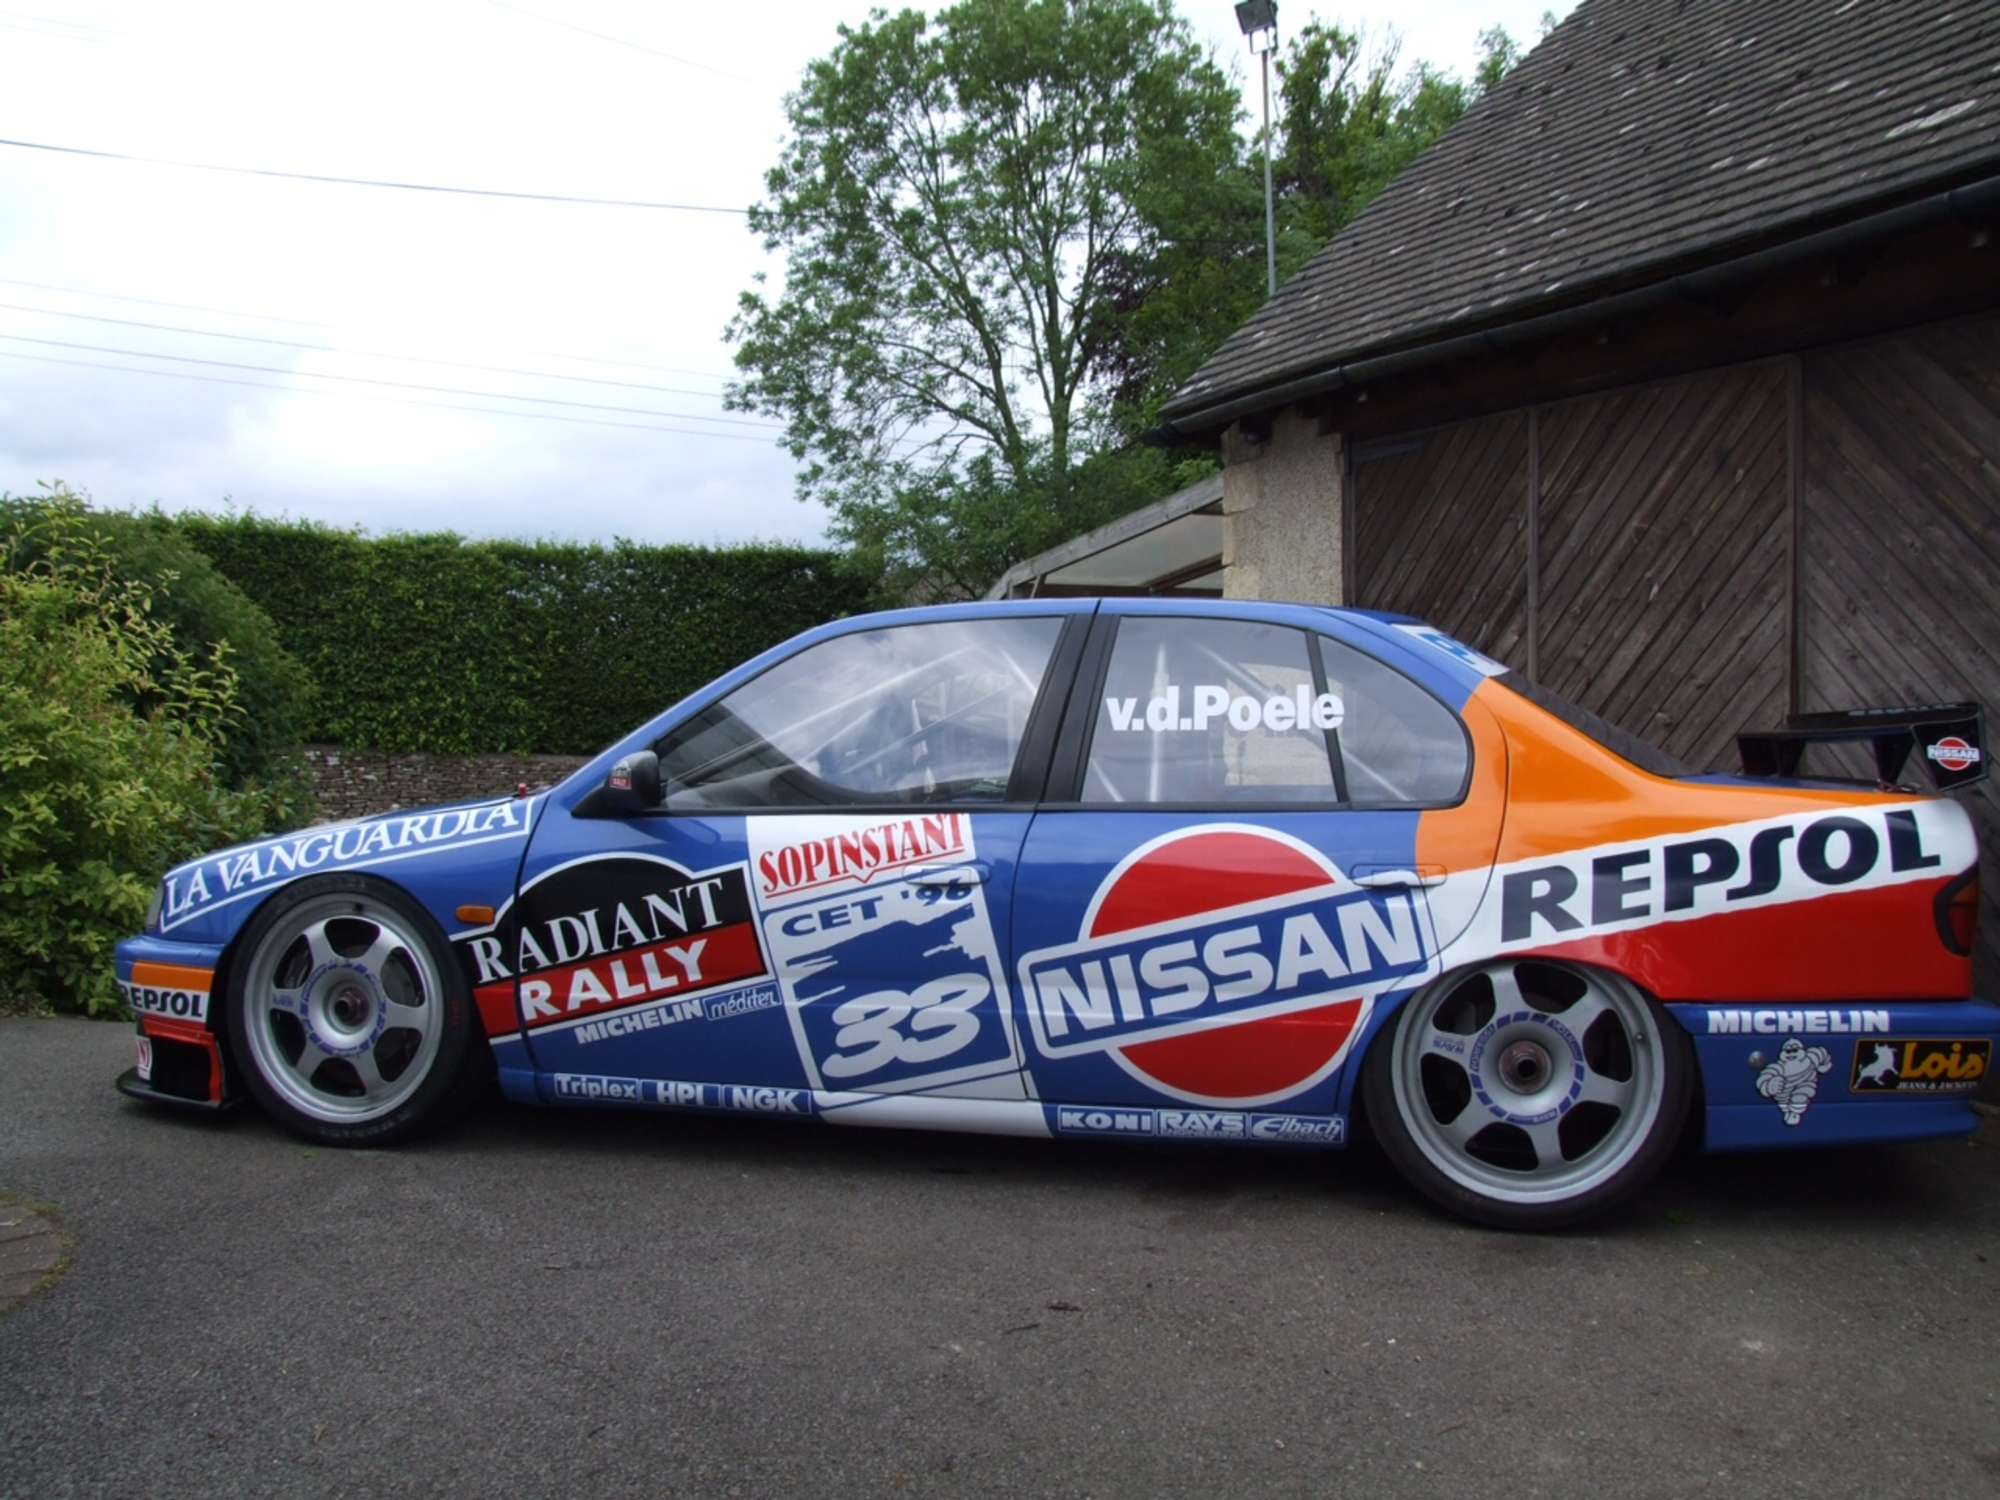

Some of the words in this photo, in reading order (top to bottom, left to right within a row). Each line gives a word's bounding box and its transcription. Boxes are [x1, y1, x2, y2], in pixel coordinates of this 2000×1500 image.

[1106, 685, 1345, 732] v.d.Poele
[166, 868, 212, 917] LA
[217, 802, 519, 891] VANGUARDIA
[759, 812, 964, 893] SOPINSTANT
[1501, 810, 1941, 943] REPSOL
[467, 878, 723, 984] RADIANT
[782, 897, 883, 937] CET
[519, 938, 708, 1022] RALLY
[1036, 895, 1421, 1038] NISSAN
[574, 999, 703, 1044] MICHELIN
[821, 973, 990, 1078] 33
[1707, 1010, 1890, 1034] MICHELIN
[1900, 1042, 1985, 1078] Lois
[557, 1076, 635, 1099] Triplex
[656, 1081, 704, 1107] HPI
[732, 1086, 799, 1112] NGK
[1061, 1110, 1150, 1131] KONI
[1160, 1111, 1244, 1133] RAYS
